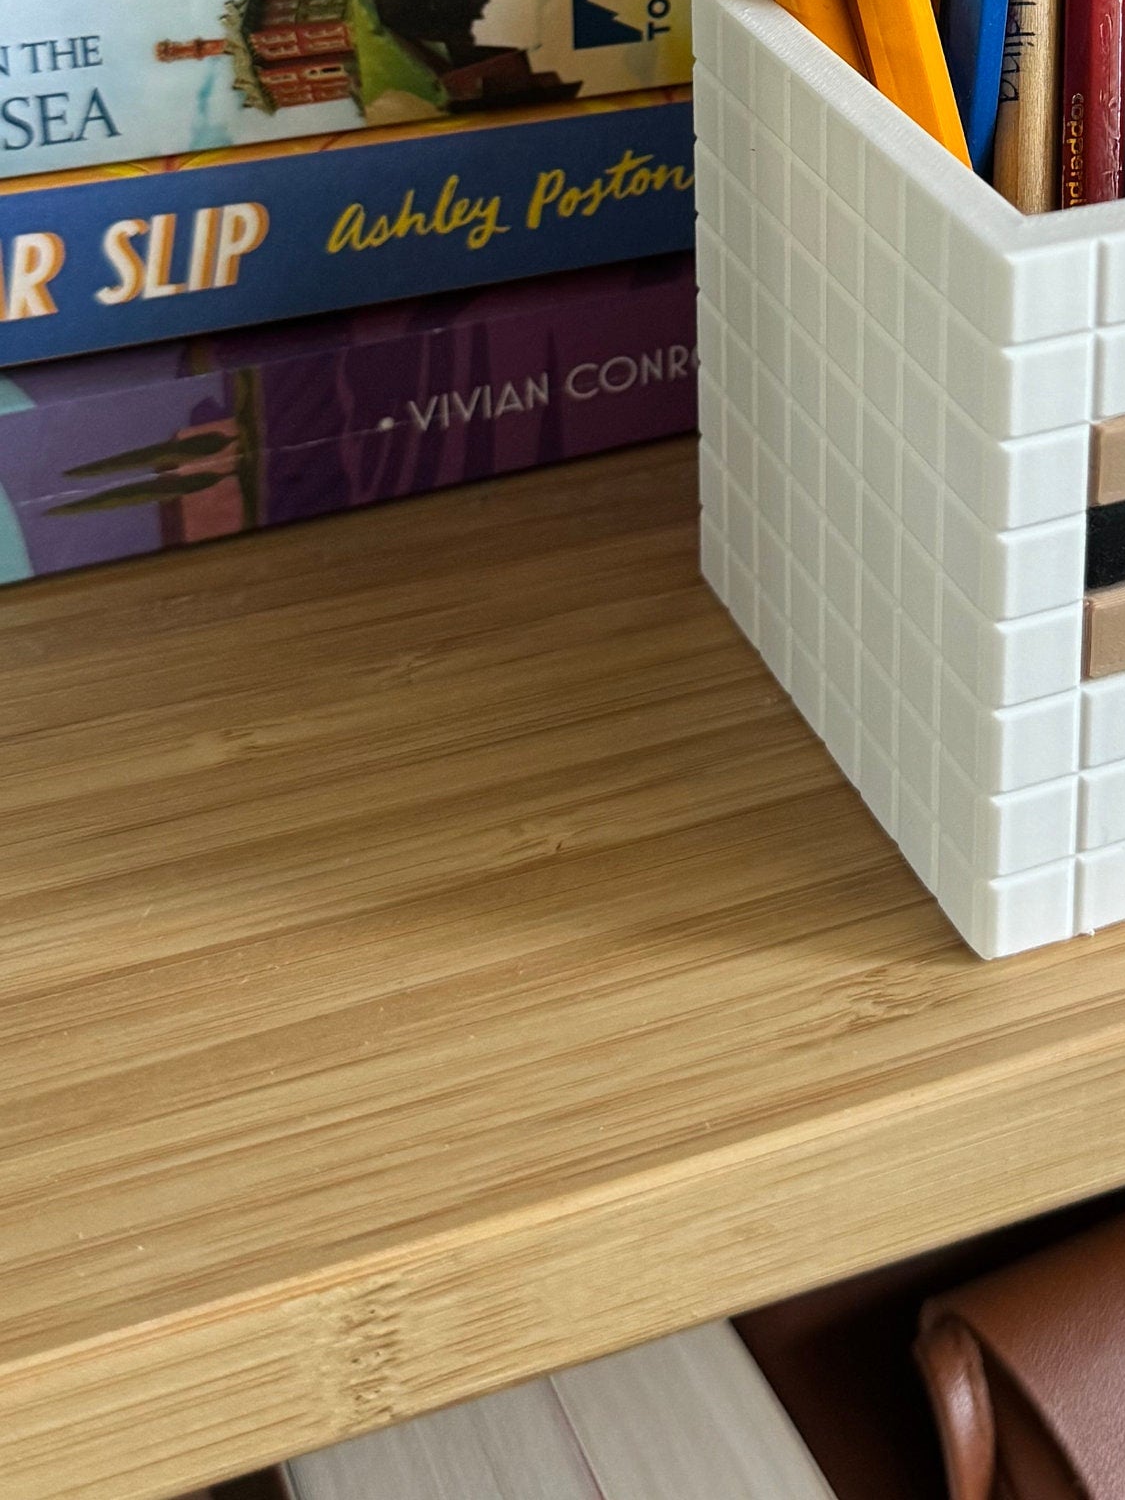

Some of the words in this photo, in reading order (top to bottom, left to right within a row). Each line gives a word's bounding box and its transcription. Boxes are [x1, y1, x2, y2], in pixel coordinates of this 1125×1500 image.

[21, 35, 104, 74] THE
[0, 86, 123, 152] SEA
[94, 201, 271, 307] SLIP
[407, 371, 550, 433] VIVIAN
[564, 344, 700, 401] CONR
